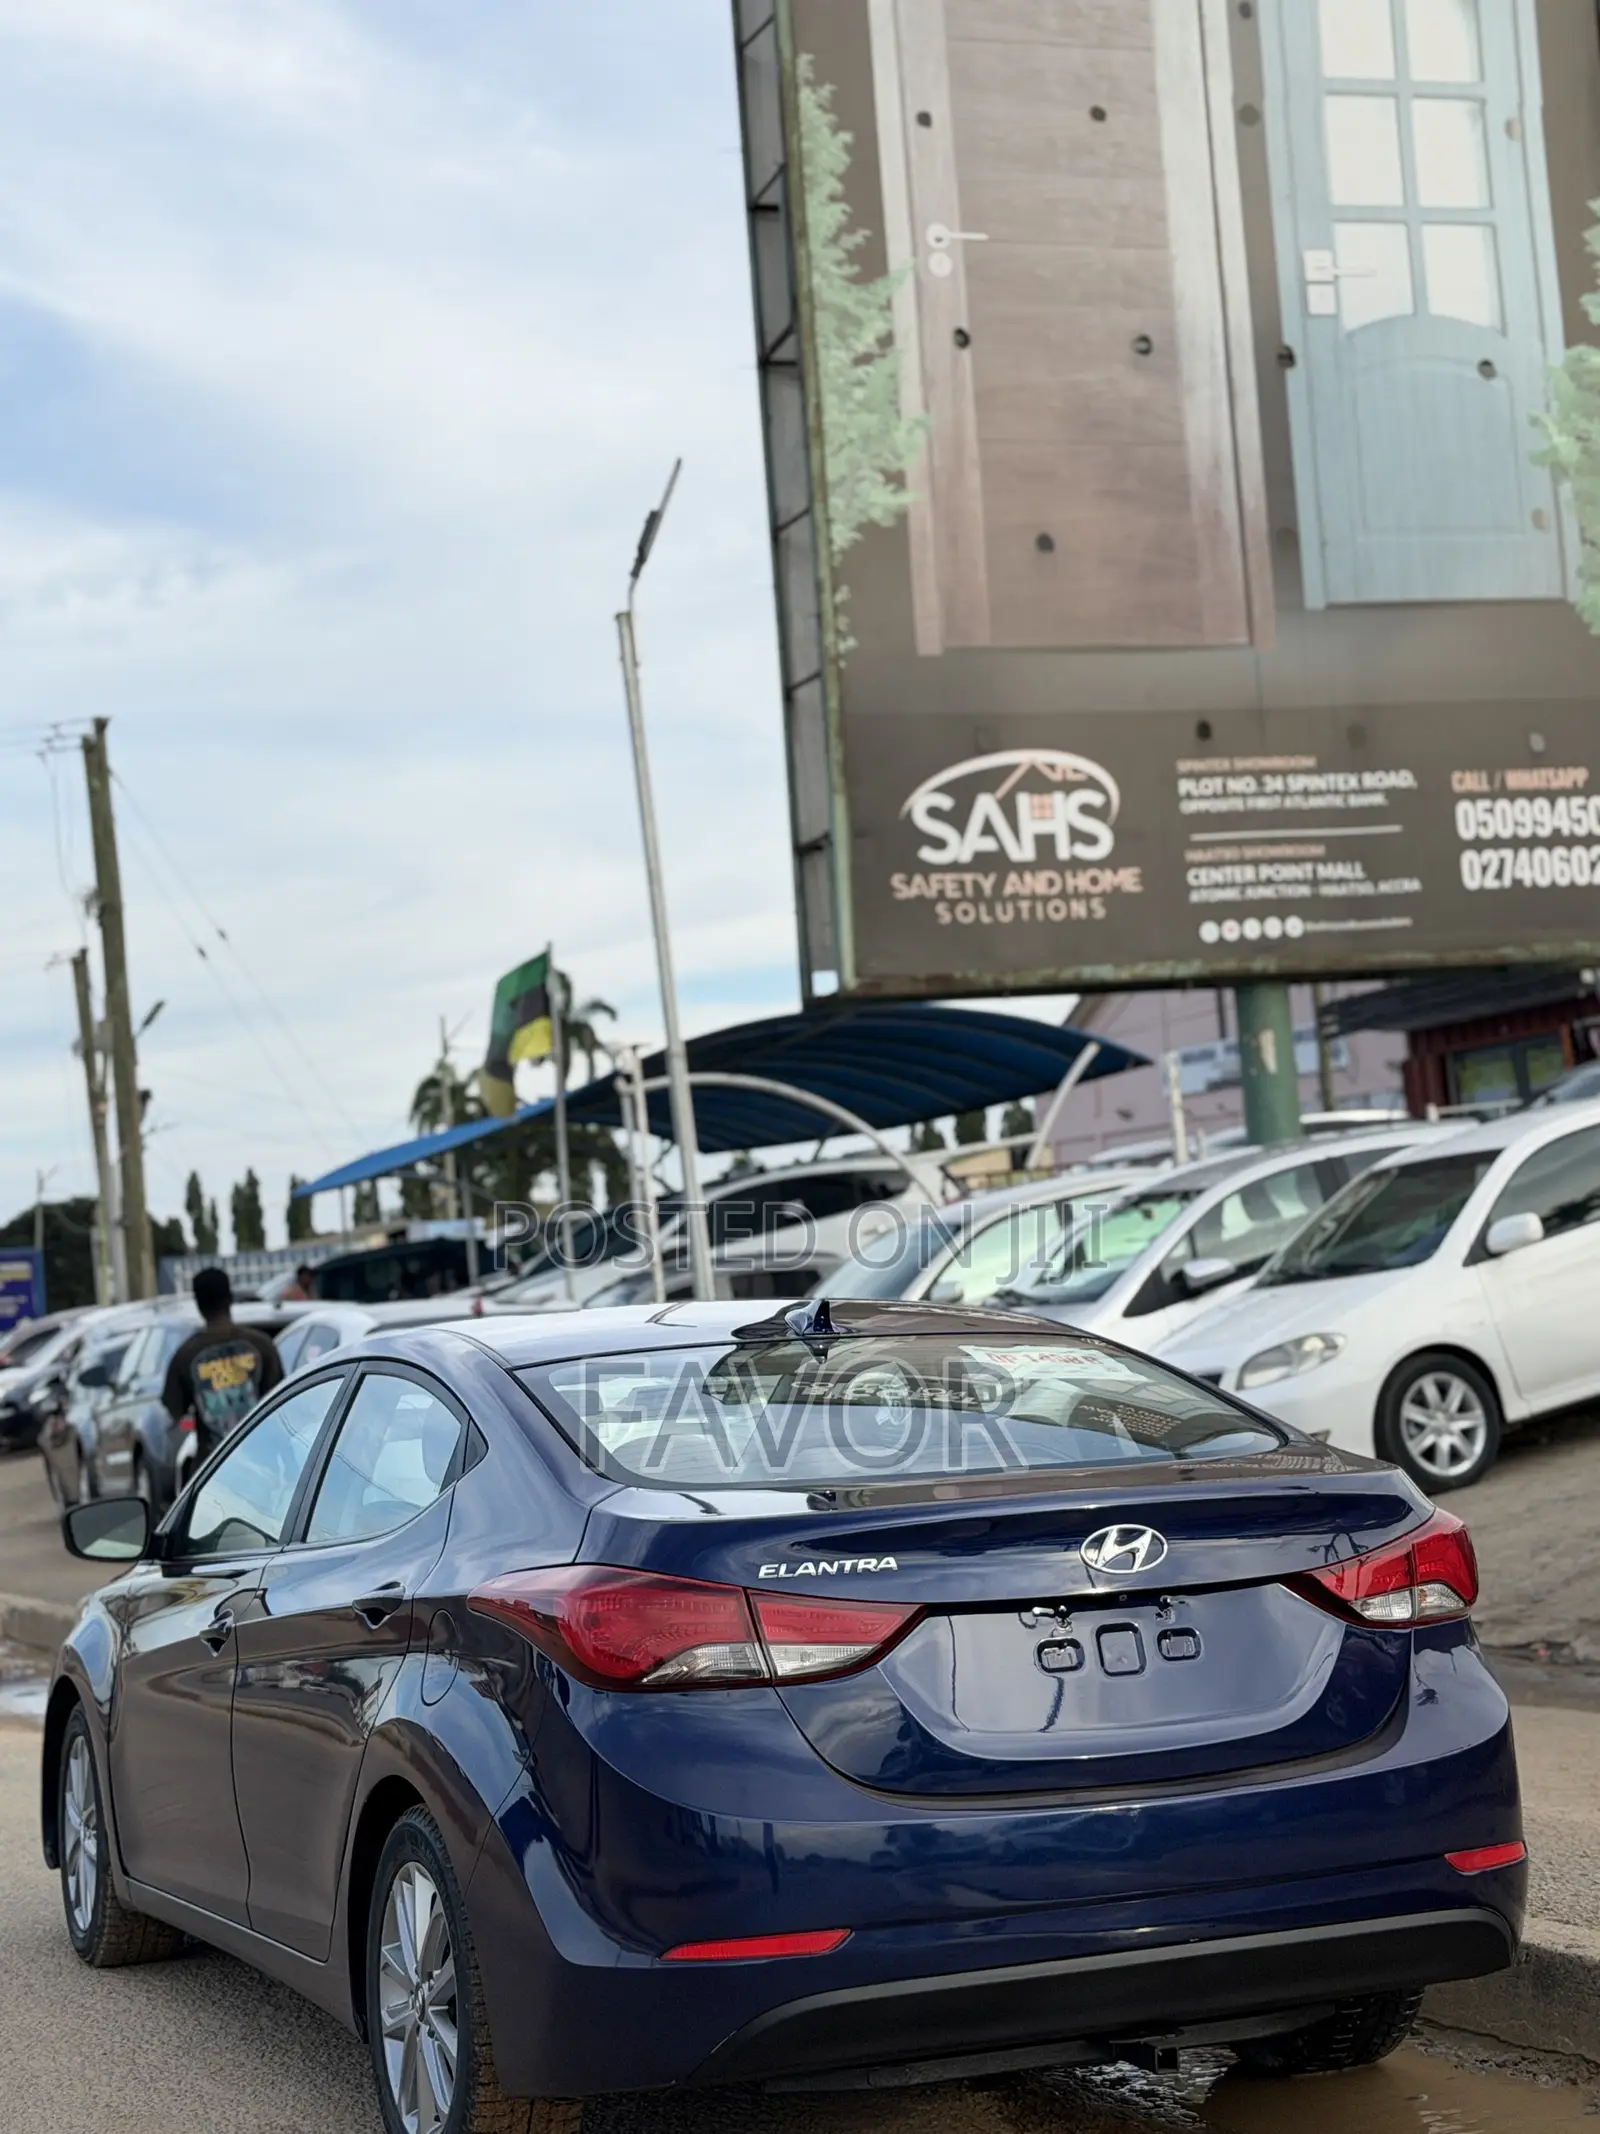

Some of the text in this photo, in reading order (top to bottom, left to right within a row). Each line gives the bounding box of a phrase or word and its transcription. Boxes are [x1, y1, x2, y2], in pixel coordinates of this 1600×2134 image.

[1451, 769, 1490, 793] CALL
[911, 788, 1115, 866] SAHS
[889, 866, 1144, 900] SAFETY AND HOME
[1186, 864, 1256, 887] CENTER
[1257, 862, 1313, 883] POINT
[934, 897, 1107, 925] SOLUTIONS
[758, 1555, 899, 1579] ELANTRA
